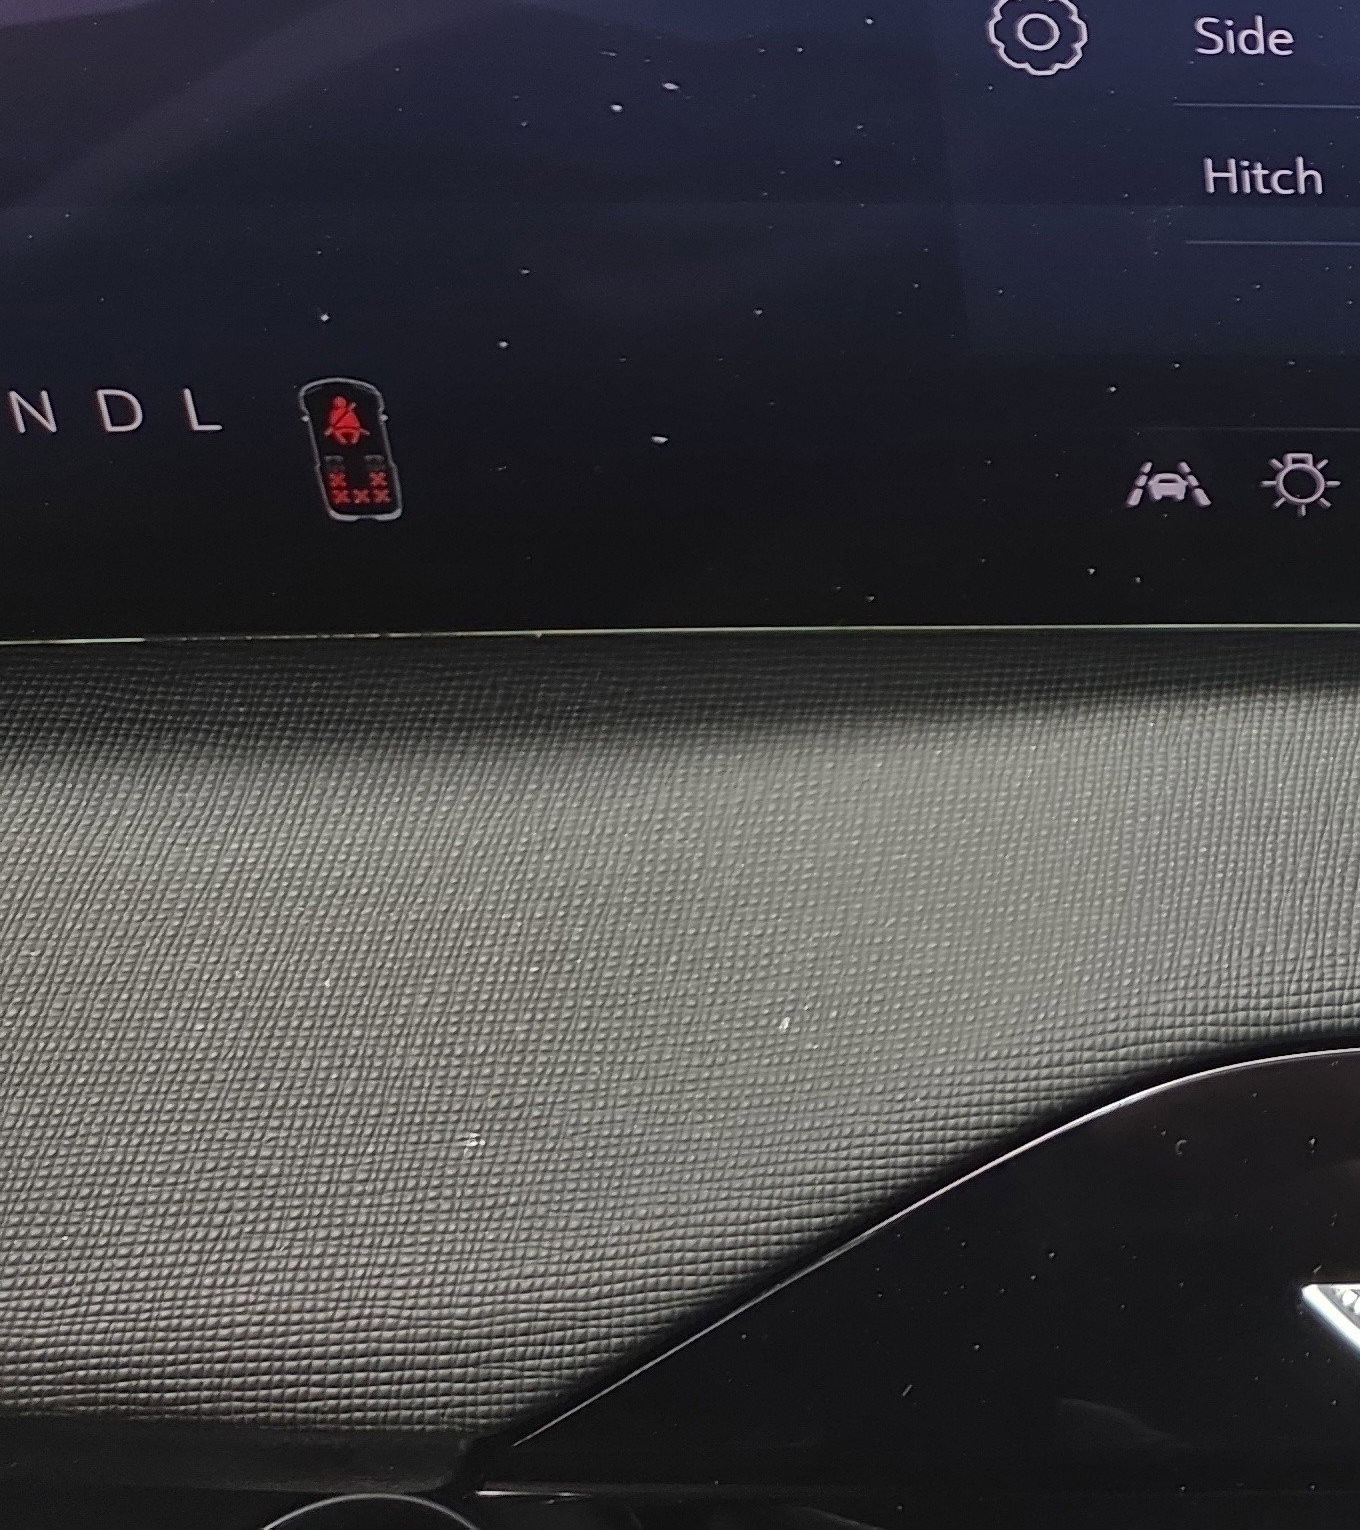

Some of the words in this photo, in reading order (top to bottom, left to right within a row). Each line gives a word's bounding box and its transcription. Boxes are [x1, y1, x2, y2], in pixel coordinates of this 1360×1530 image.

[1194, 15, 1294, 56] Side
[1203, 156, 1323, 195] Hitch
[9, 389, 57, 433] N
[97, 388, 143, 433] D
[183, 388, 223, 431] L
